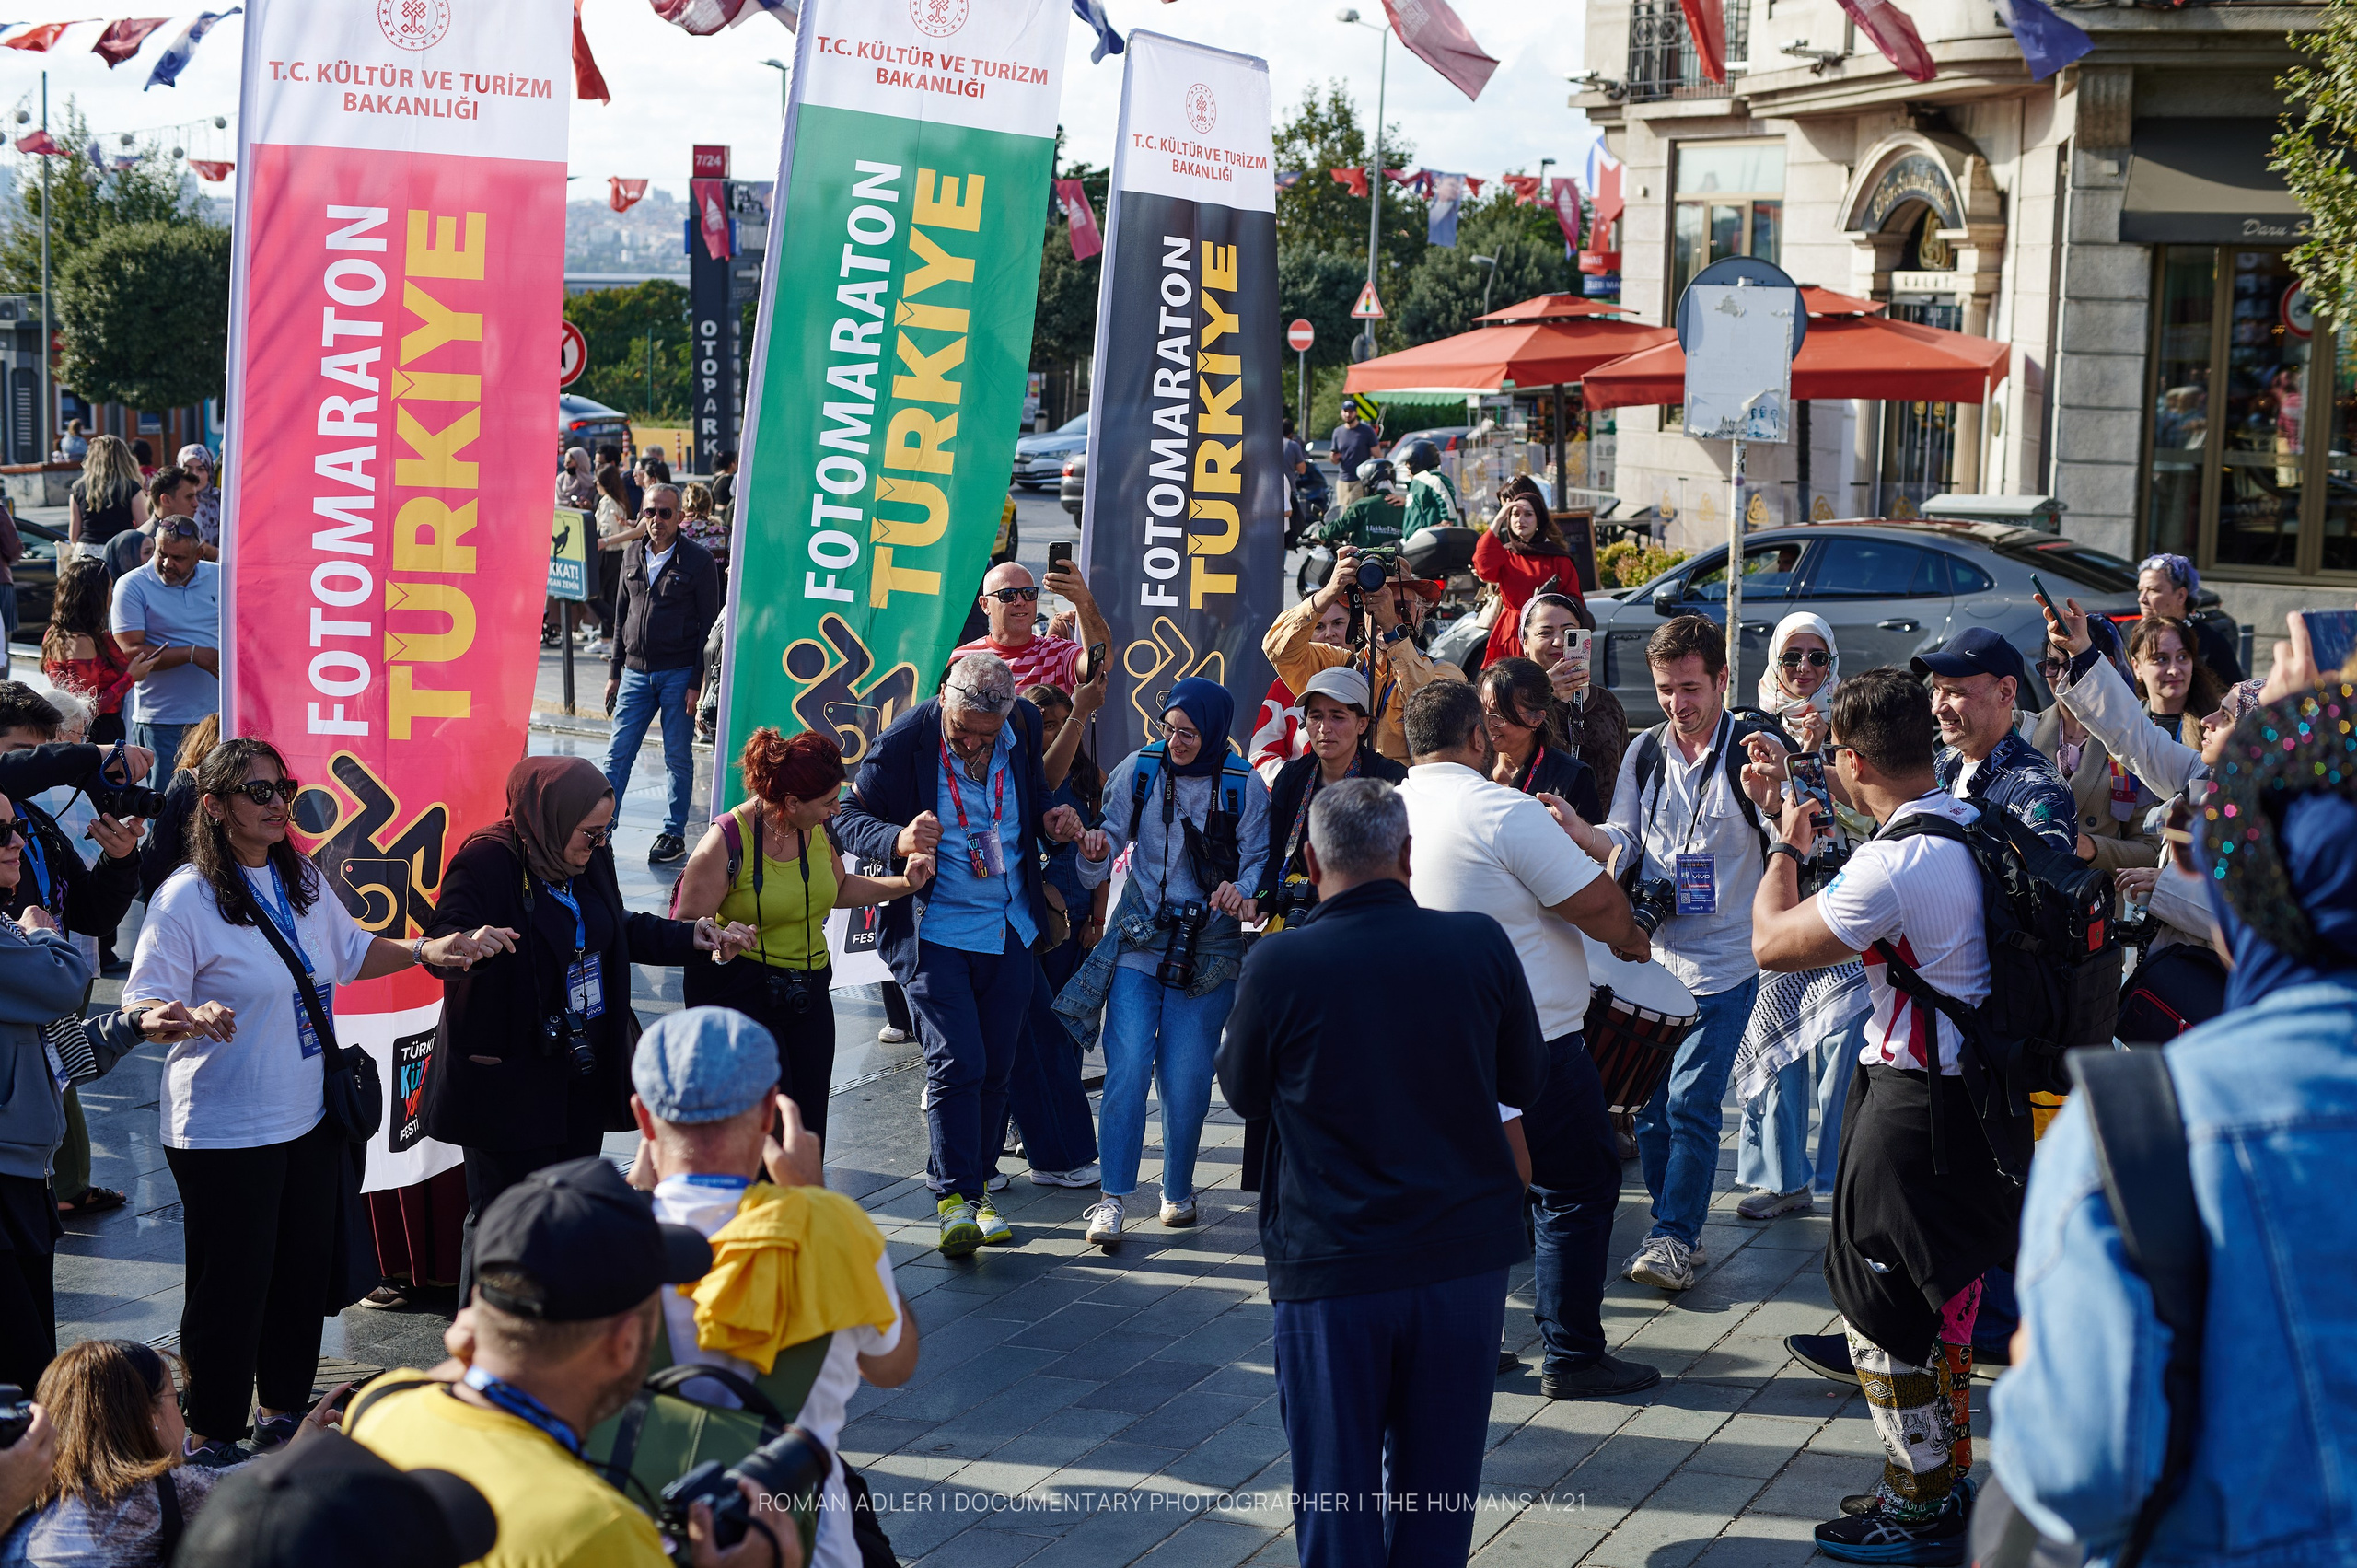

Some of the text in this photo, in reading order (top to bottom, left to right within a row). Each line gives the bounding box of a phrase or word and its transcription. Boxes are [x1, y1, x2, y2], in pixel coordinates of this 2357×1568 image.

[817, 36, 1049, 85] T.C. KÜLTÜR VE TURİZM
[269, 60, 552, 99] T.C. KÜLTÜR VE TURİZM
[876, 67, 985, 99] BAKANLIĞI
[343, 92, 479, 121] BAKANLIĞI
[695, 154, 722, 167] 7/24
[1132, 134, 1268, 169] T.C. KÜLTÜR VE TURİZM
[1172, 158, 1232, 182] BAKANLIĞI
[700, 319, 719, 456] OTOPARK
[804, 159, 902, 603] FOTOMARATON
[1140, 235, 1192, 607] FOTOMARATON
[307, 203, 389, 736] FOTOMARATON
[548, 578, 562, 587] GAN
[549, 562, 579, 580] KKAT!
[586, 1005, 602, 1016] vivo
[401, 1032, 436, 1062] TÜRKİ
[401, 1054, 432, 1099] KÜLT
[399, 1114, 420, 1142] FESTİ
